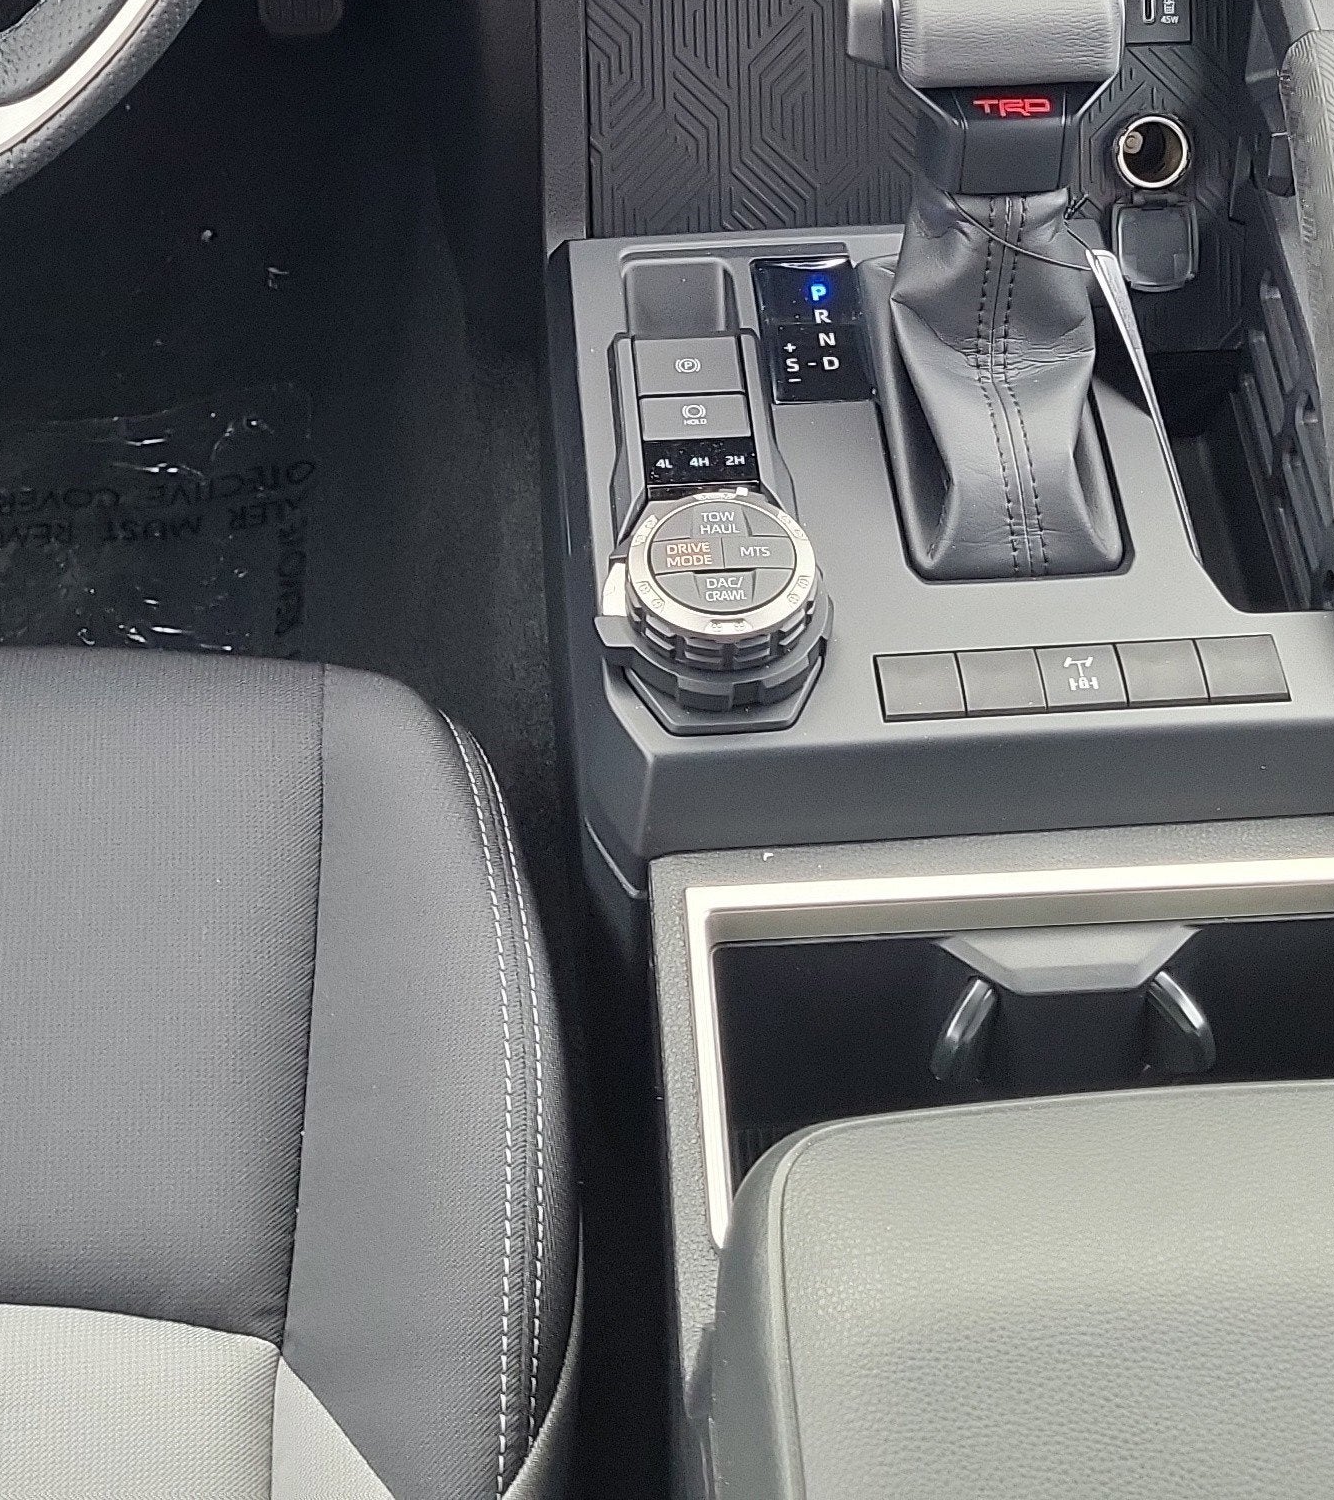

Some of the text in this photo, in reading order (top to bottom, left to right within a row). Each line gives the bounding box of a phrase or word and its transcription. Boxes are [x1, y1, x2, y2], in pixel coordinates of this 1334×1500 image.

[1161, 16, 1179, 24] 45W
[973, 98, 1051, 118] TRD
[810, 284, 827, 301] P
[814, 309, 832, 324] R
[818, 332, 837, 347] N
[822, 356, 840, 371] D
[683, 418, 708, 426] HOLD
[655, 455, 746, 469] 4L 4H 2H
[701, 511, 735, 522] TOW
[700, 523, 741, 535] HAUL
[666, 542, 711, 554] DRIVE
[740, 546, 771, 557] MTS
[666, 555, 713, 568] MODE
[706, 576, 744, 589] DAC/
[705, 591, 748, 602] CRAWL
